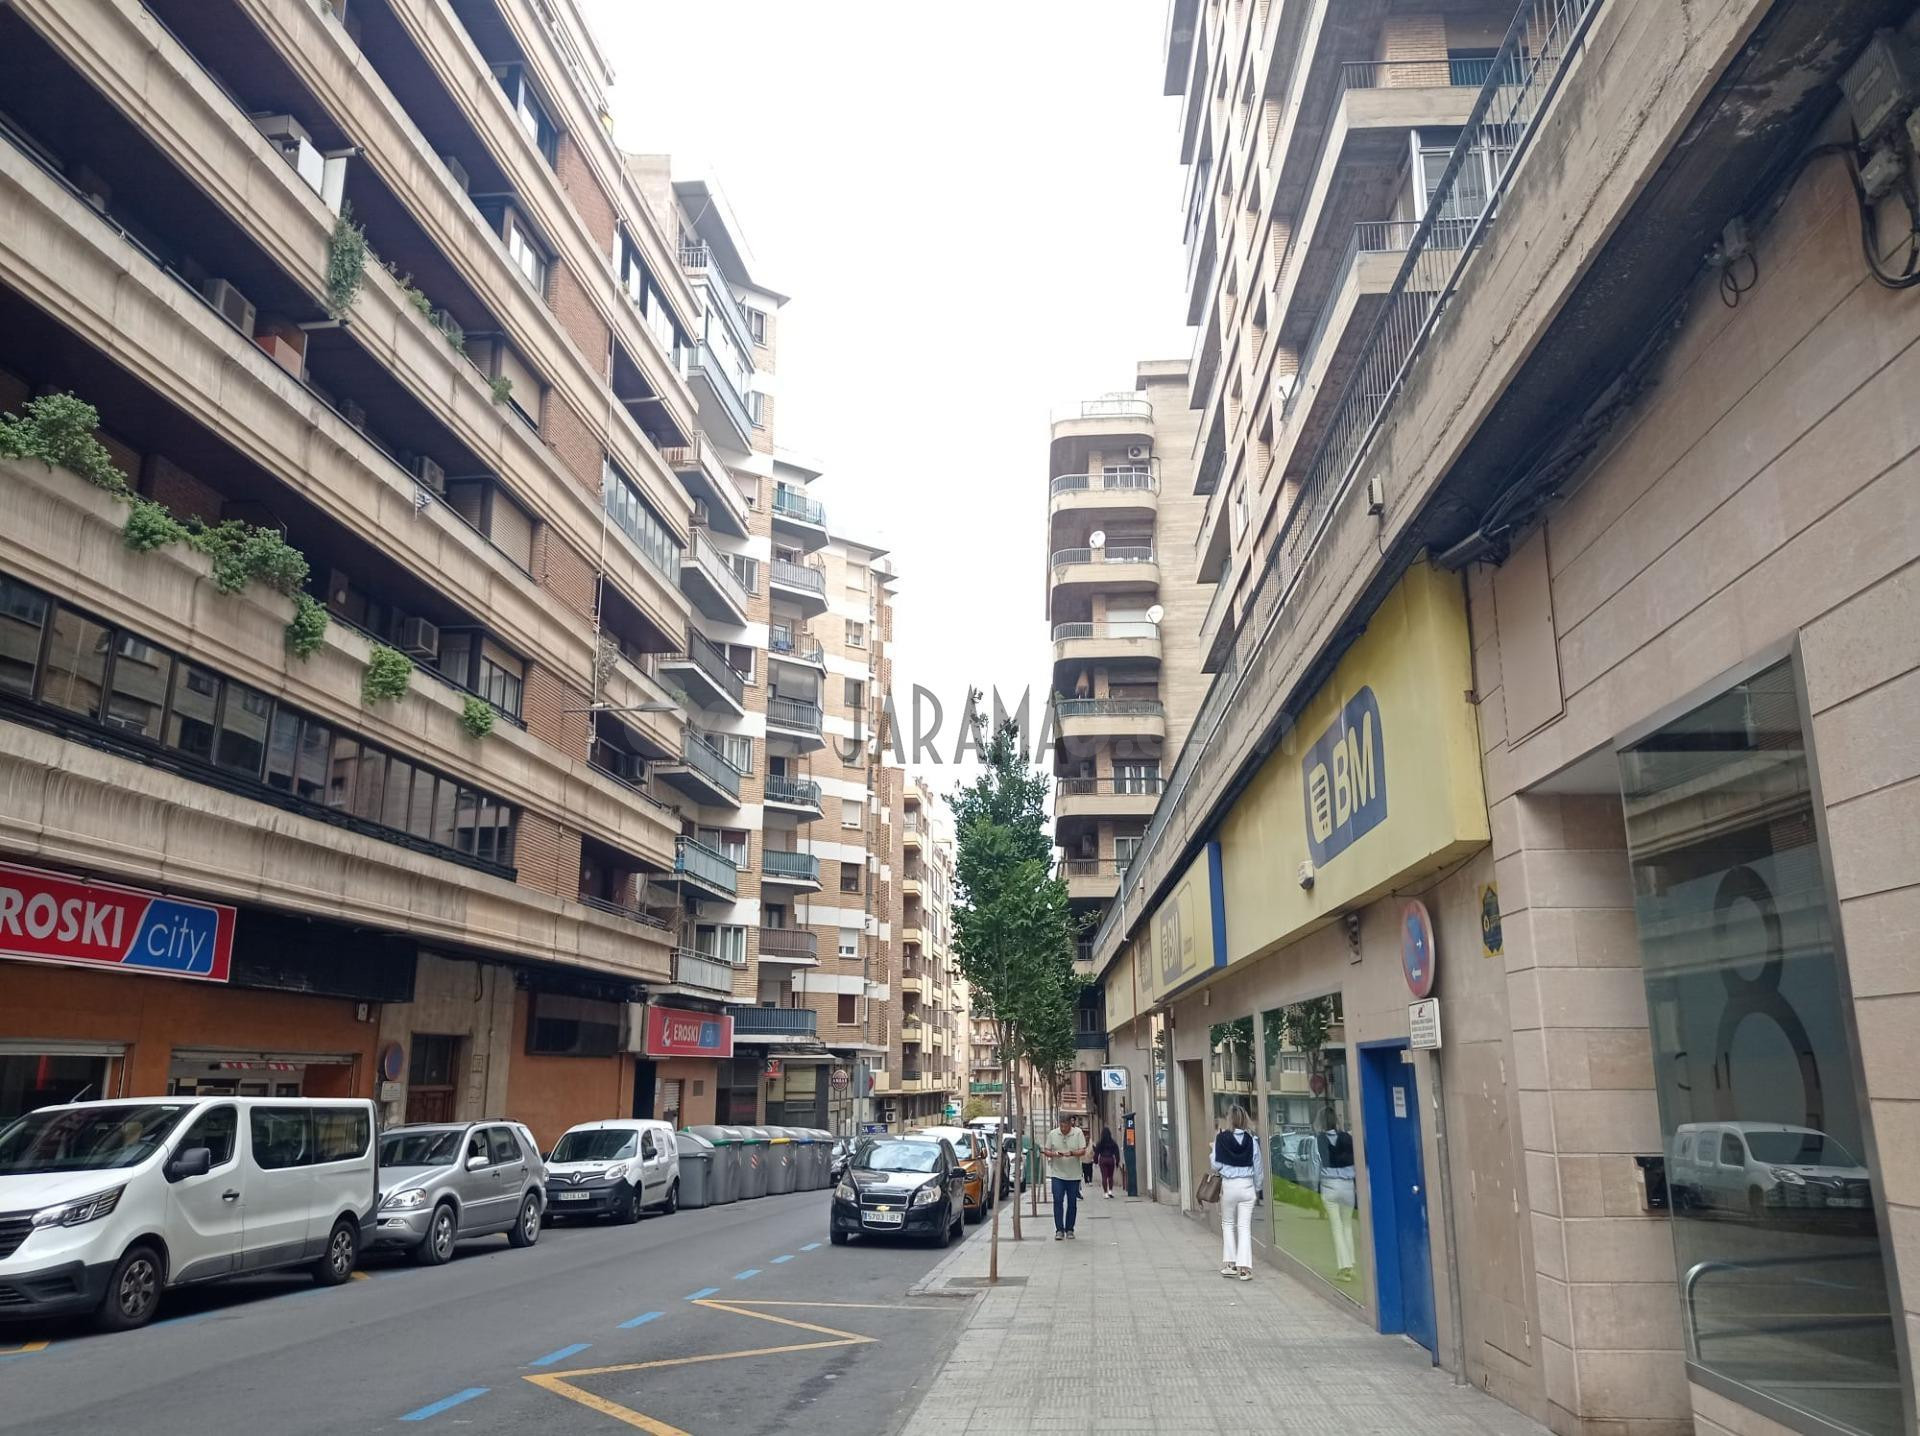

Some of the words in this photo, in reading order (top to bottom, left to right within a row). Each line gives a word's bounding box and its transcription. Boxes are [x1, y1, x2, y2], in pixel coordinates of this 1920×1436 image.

[1333, 710, 1376, 829] BM
[0, 886, 125, 949] ROSKI
[147, 914, 207, 970] city
[1167, 911, 1180, 970] BM
[673, 1023, 699, 1043] EROSKI
